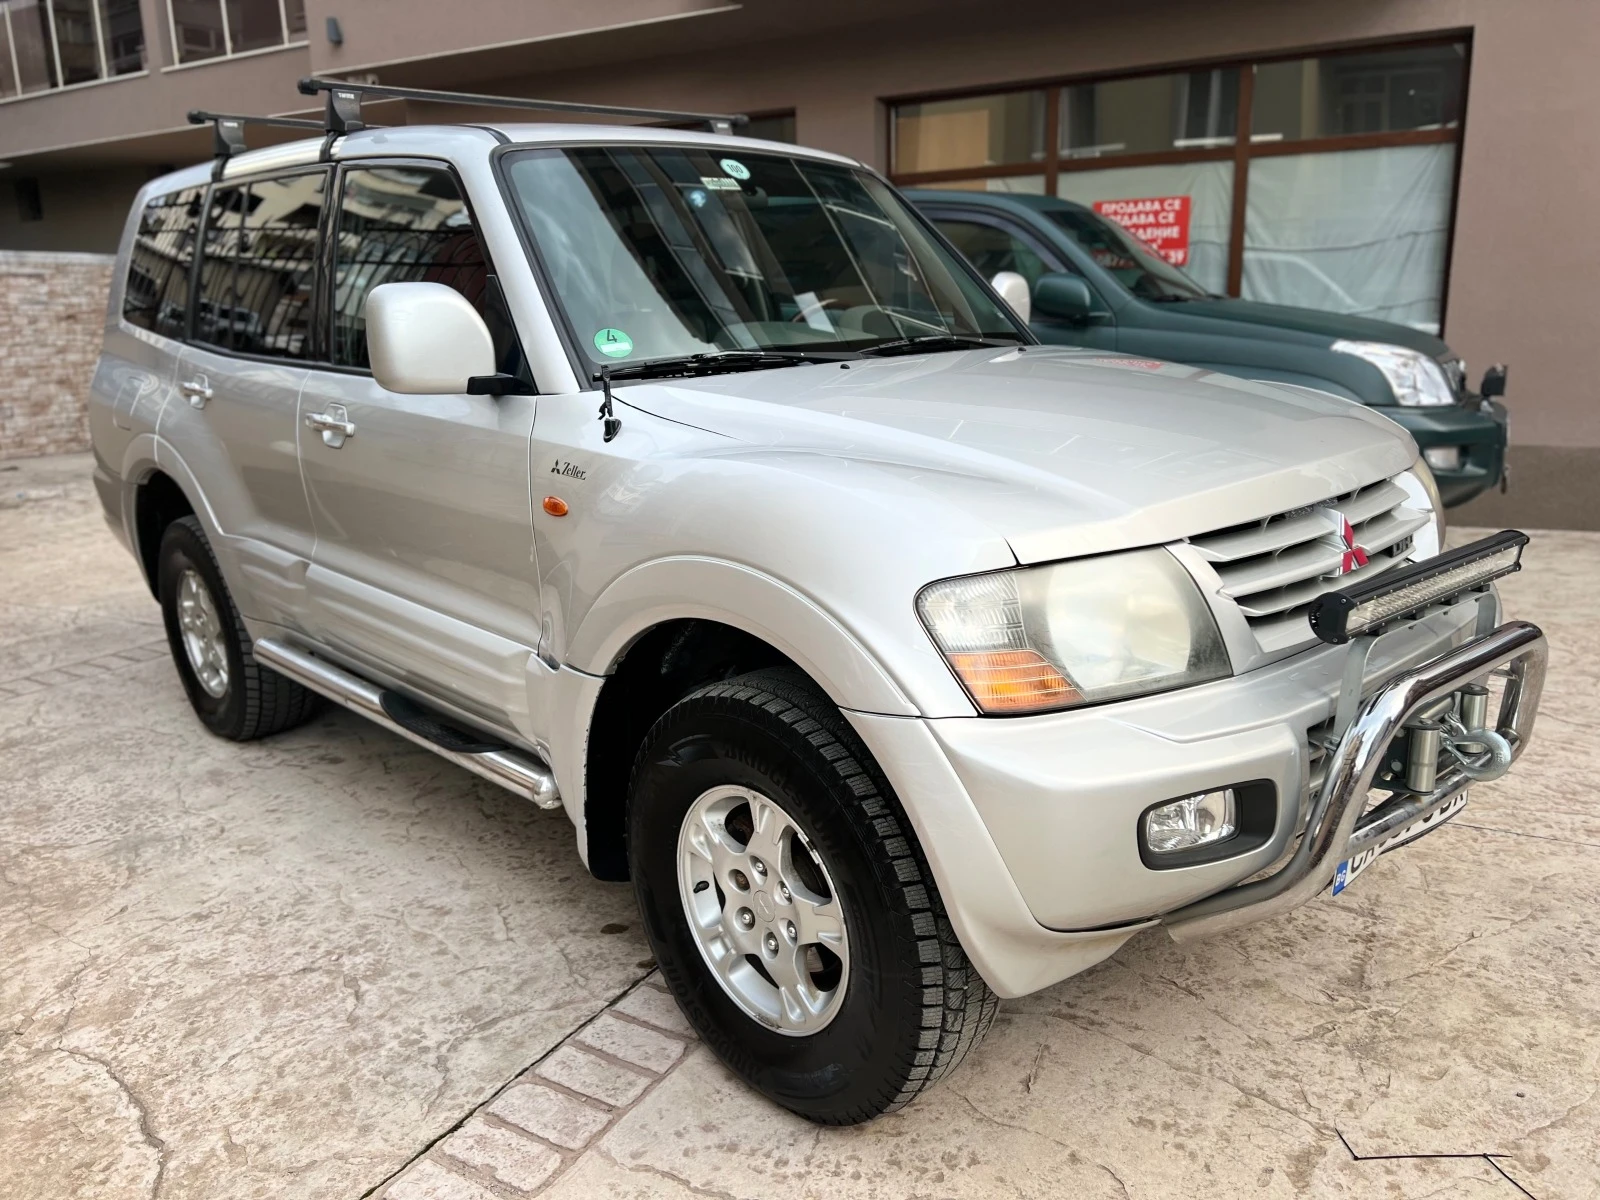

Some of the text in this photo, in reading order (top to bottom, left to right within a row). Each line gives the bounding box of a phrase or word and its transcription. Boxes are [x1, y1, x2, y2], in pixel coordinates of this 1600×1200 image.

[1101, 198, 1182, 213] ПРОДАВА СЕ
[1158, 211, 1176, 223] СЕ
[606, 329, 618, 343] 4
[561, 461, 586, 480] Zeller
